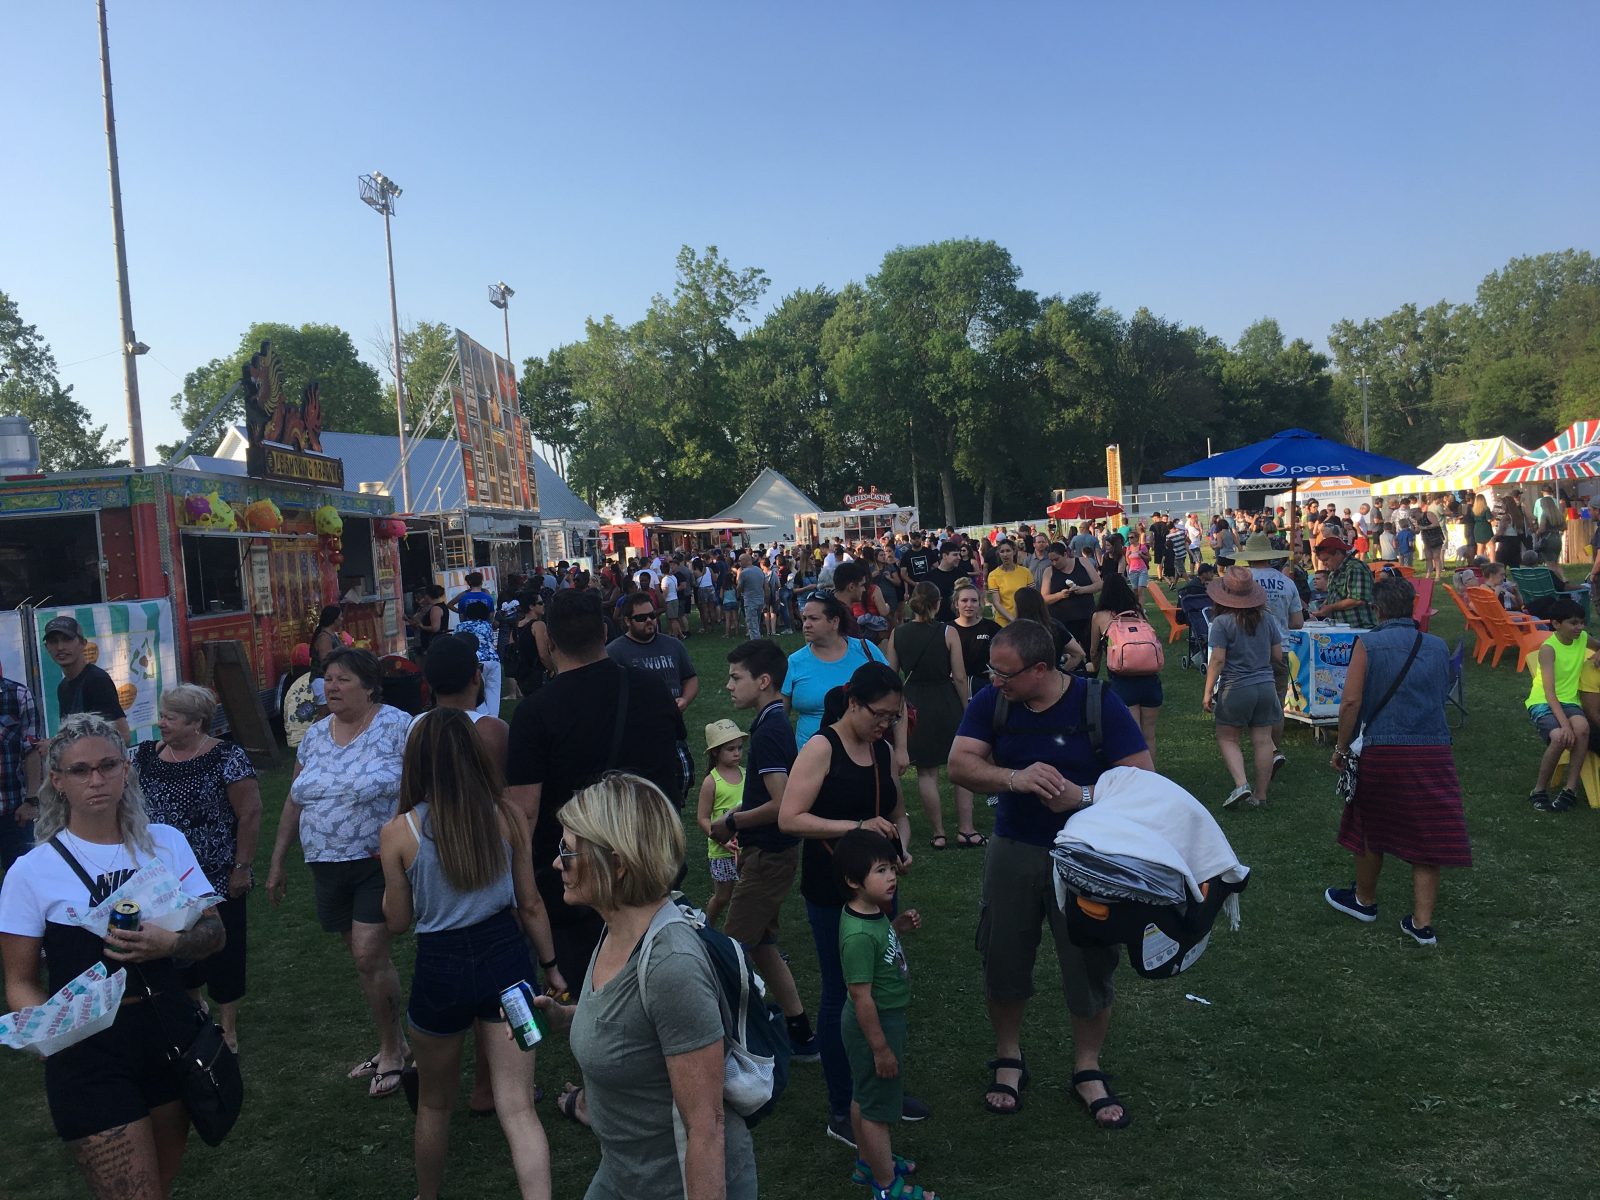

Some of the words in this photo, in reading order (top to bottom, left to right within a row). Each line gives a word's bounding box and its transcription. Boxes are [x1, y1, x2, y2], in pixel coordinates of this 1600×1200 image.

[1290, 463, 1346, 475] pepsi
[870, 491, 891, 503] CASTOR
[1256, 578, 1285, 591] ANS
[642, 655, 675, 670] WORK
